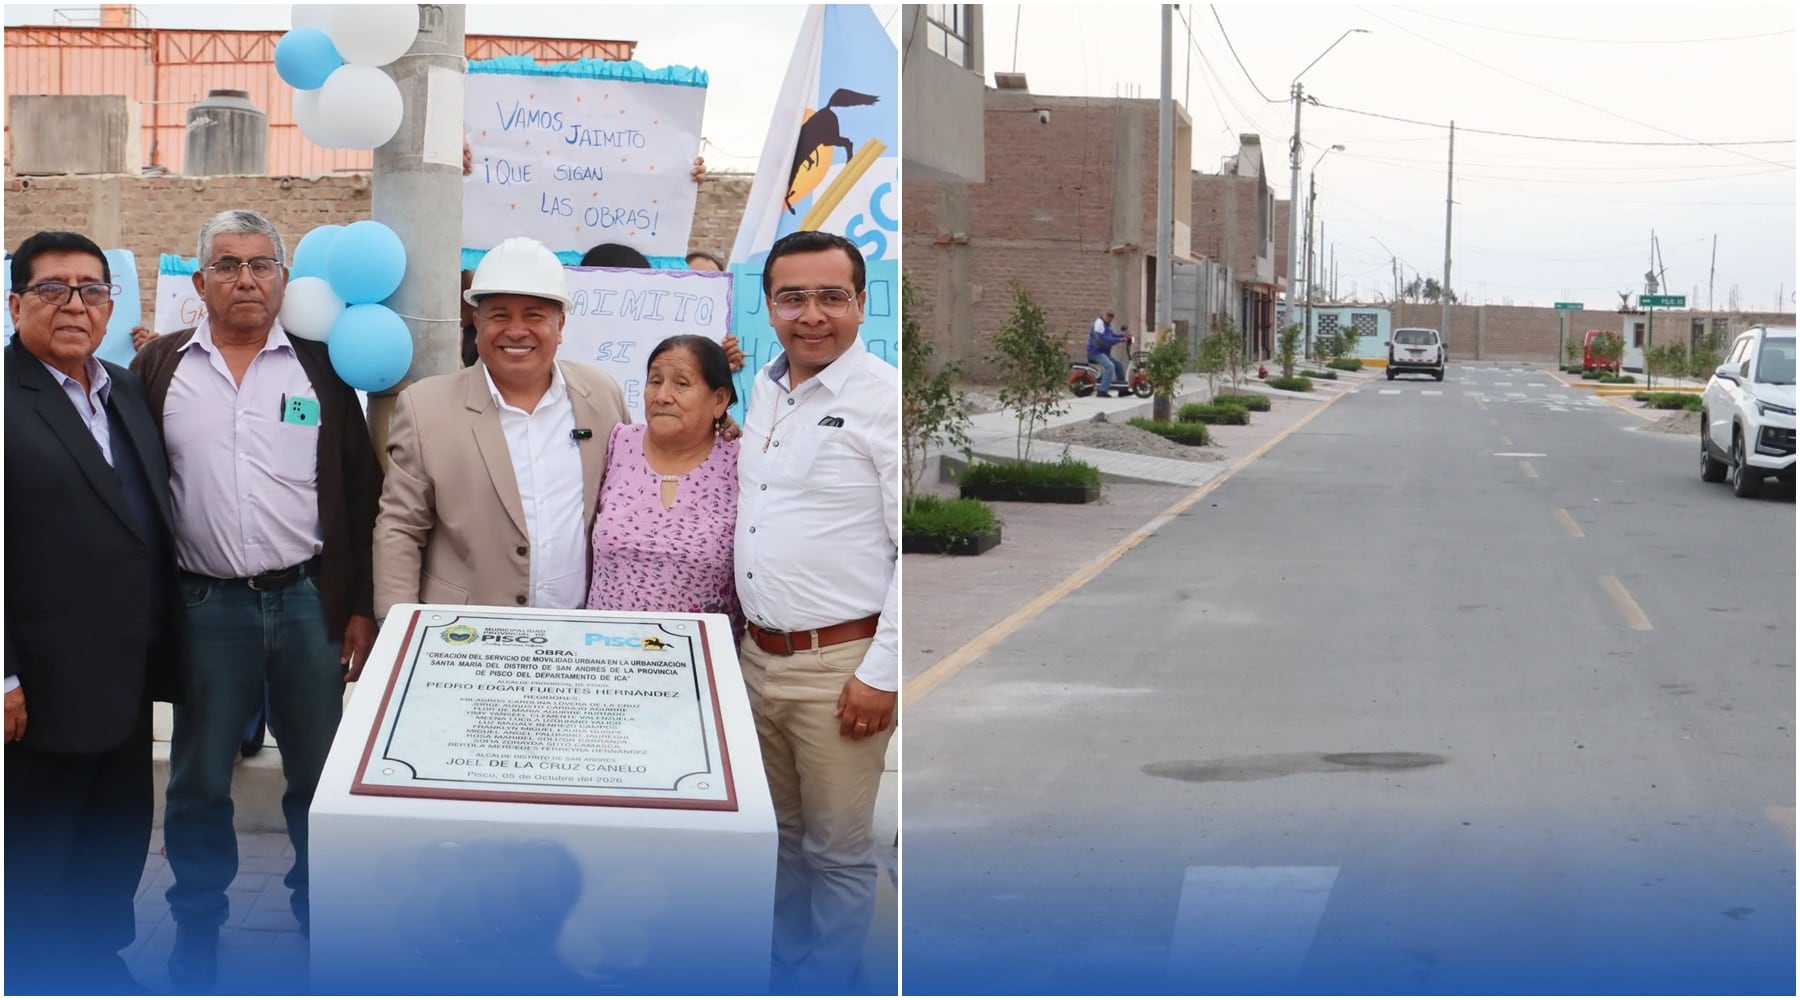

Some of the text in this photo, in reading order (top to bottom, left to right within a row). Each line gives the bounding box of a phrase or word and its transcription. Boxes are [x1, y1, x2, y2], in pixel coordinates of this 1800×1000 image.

[497, 101, 645, 149] VAMOS JAIMITO
[553, 165, 603, 181] SIGAN
[540, 192, 658, 236] LAS OBRAS!
[596, 340, 637, 364] SI
[481, 635, 548, 644] PISCO
[533, 656, 573, 664] MOVILIDAD
[631, 659, 686, 668] URBANIZACIÓN
[535, 672, 596, 681] DEPARTAMENTO
[638, 668, 678, 676] PROVINCIA
[427, 682, 473, 690] PEDRO
[478, 684, 525, 692] EDGAR
[530, 686, 591, 695] FUENTES
[446, 758, 647, 774] JOEL DE LA CRUZ CANELO
[534, 774, 574, 782] Octubre
